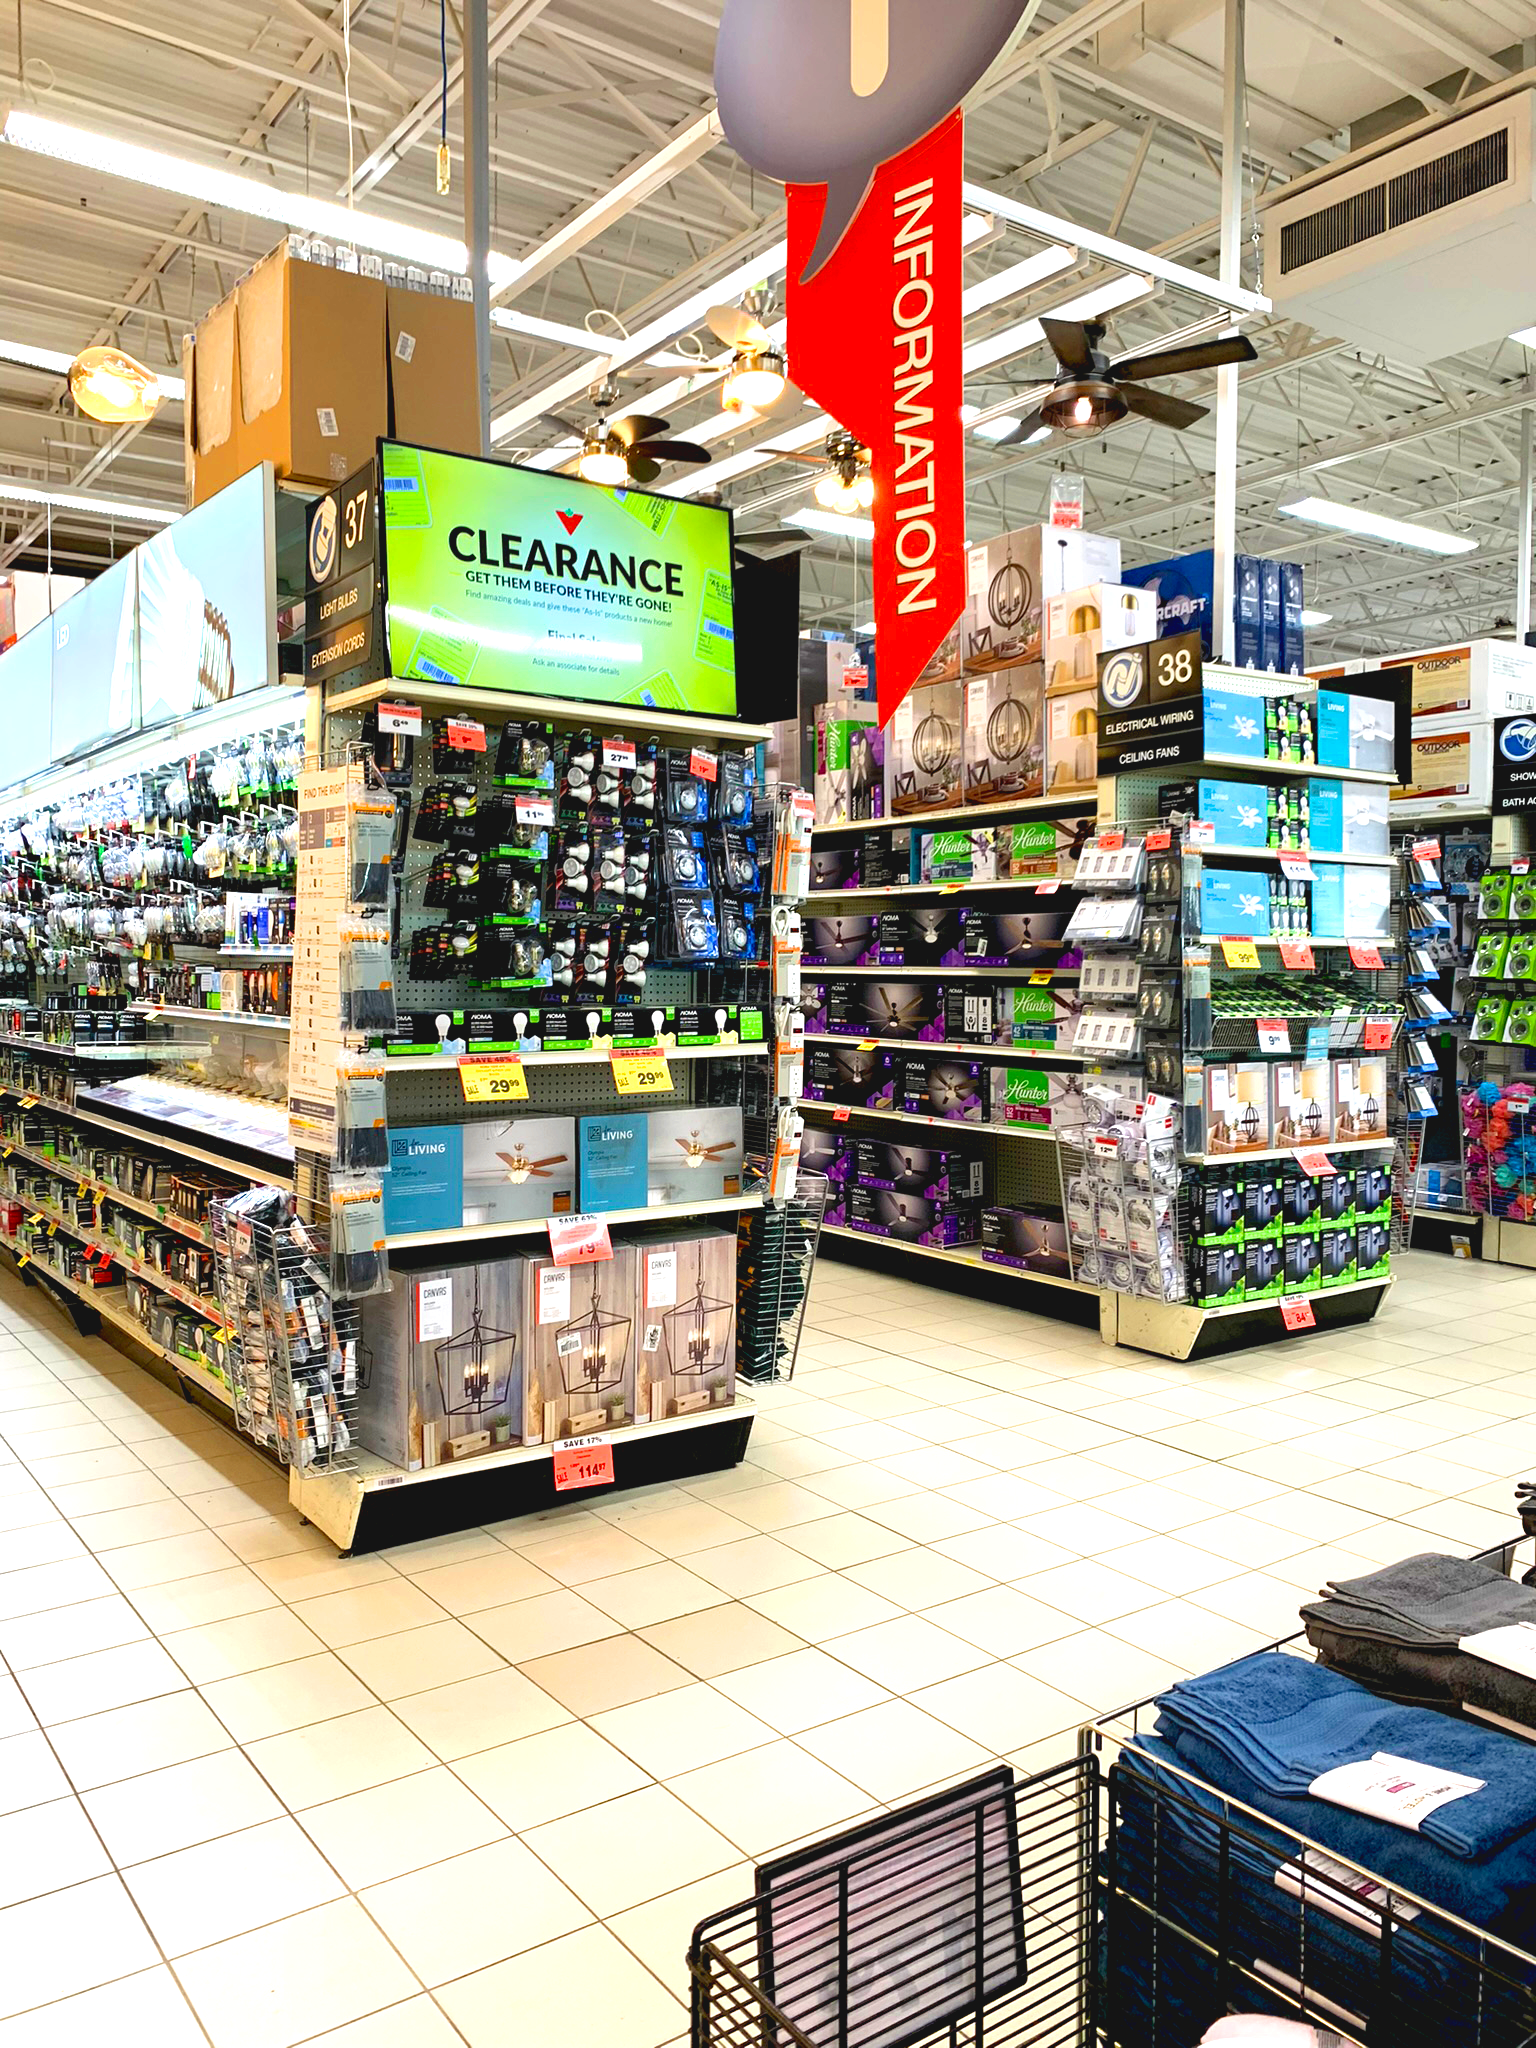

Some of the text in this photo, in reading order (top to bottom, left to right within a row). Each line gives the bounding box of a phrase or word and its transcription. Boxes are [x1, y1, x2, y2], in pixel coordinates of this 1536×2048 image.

[893, 178, 937, 616] INFORMATION
[345, 490, 369, 550] 37
[448, 525, 684, 597] CLEARANCE
[466, 570, 672, 613] GET THEM BEFORE THEY'RE GONE!
[319, 587, 358, 621] LIGHT BULBS
[466, 589, 481, 600] Find
[483, 592, 512, 605] amazing
[514, 595, 531, 607] deals
[533, 598, 545, 609] and
[547, 601, 560, 612] give
[562, 602, 580, 613] these
[605, 609, 632, 622] products
[640, 616, 652, 624] new
[654, 617, 673, 628] home!
[1157, 598, 1206, 621] RCRAFT
[56, 624, 69, 650] LED
[311, 632, 365, 669] EXTENSION CORDS
[533, 657, 620, 677] Ask an associate for details
[1157, 648, 1192, 688] 38
[1417, 655, 1461, 670] OUTDOOR
[1210, 702, 1227, 711] LIVING
[1328, 703, 1345, 713] LIVING
[1105, 715, 1158, 737] ELECTRICAL
[1160, 709, 1195, 728] WIRING
[1417, 740, 1461, 752] OUTDOOR
[670, 759, 687, 767] NOMA
[1119, 745, 1180, 766] CEILING FANS
[303, 782, 345, 800] FIND THE RIGHT
[1211, 793, 1229, 801] LIVING
[1319, 789, 1338, 799] LIVING
[1502, 798, 1526, 807] BATH
[931, 835, 971, 857] Hunter
[1009, 827, 1055, 852] Hunter
[1213, 881, 1230, 890] LIVING
[1322, 874, 1340, 882] LIVING
[1013, 992, 1054, 1014] Hunter
[906, 1062, 925, 1071] NOMA
[1004, 1079, 1048, 1101] Hunter
[602, 1130, 633, 1142] LIVING
[409, 1143, 446, 1156] LIVING
[558, 1216, 580, 1225] SAVE
[652, 1259, 672, 1270] CANVAS
[544, 1272, 566, 1284] CANVAS
[424, 1287, 447, 1299] CANVAS
[563, 1436, 602, 1449] SAVE 17%
